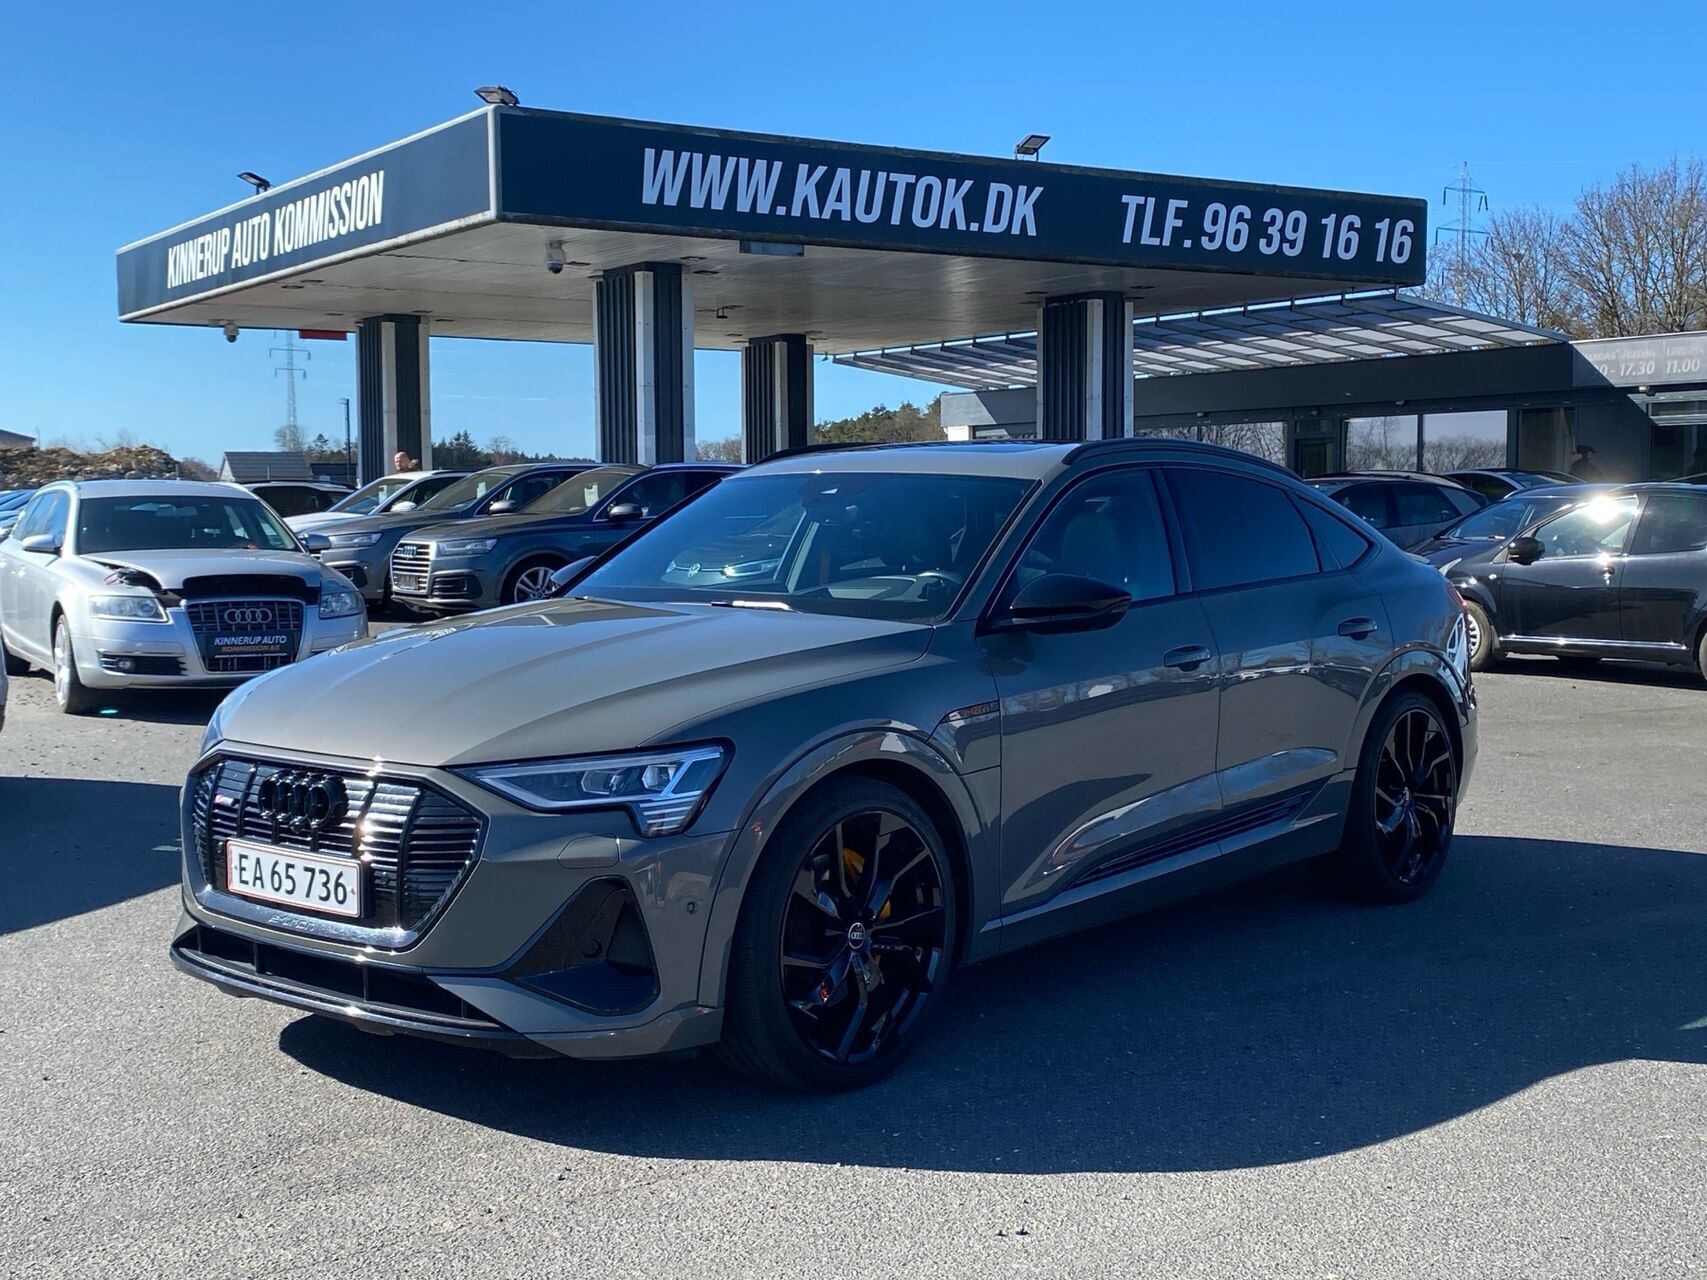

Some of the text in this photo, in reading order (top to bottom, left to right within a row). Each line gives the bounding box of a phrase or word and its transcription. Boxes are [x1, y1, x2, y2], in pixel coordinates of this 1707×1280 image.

[641, 147, 1044, 237] WWW.KAUTOK.DK
[167, 170, 385, 289] KINNERUP AUTO KOMMISSION
[1121, 194, 1415, 265] TLF. 96 39 16 16
[1619, 360, 1656, 377] 17.30
[214, 635, 287, 645] KINNERUP AUTO
[238, 853, 347, 905] EA 65 736
